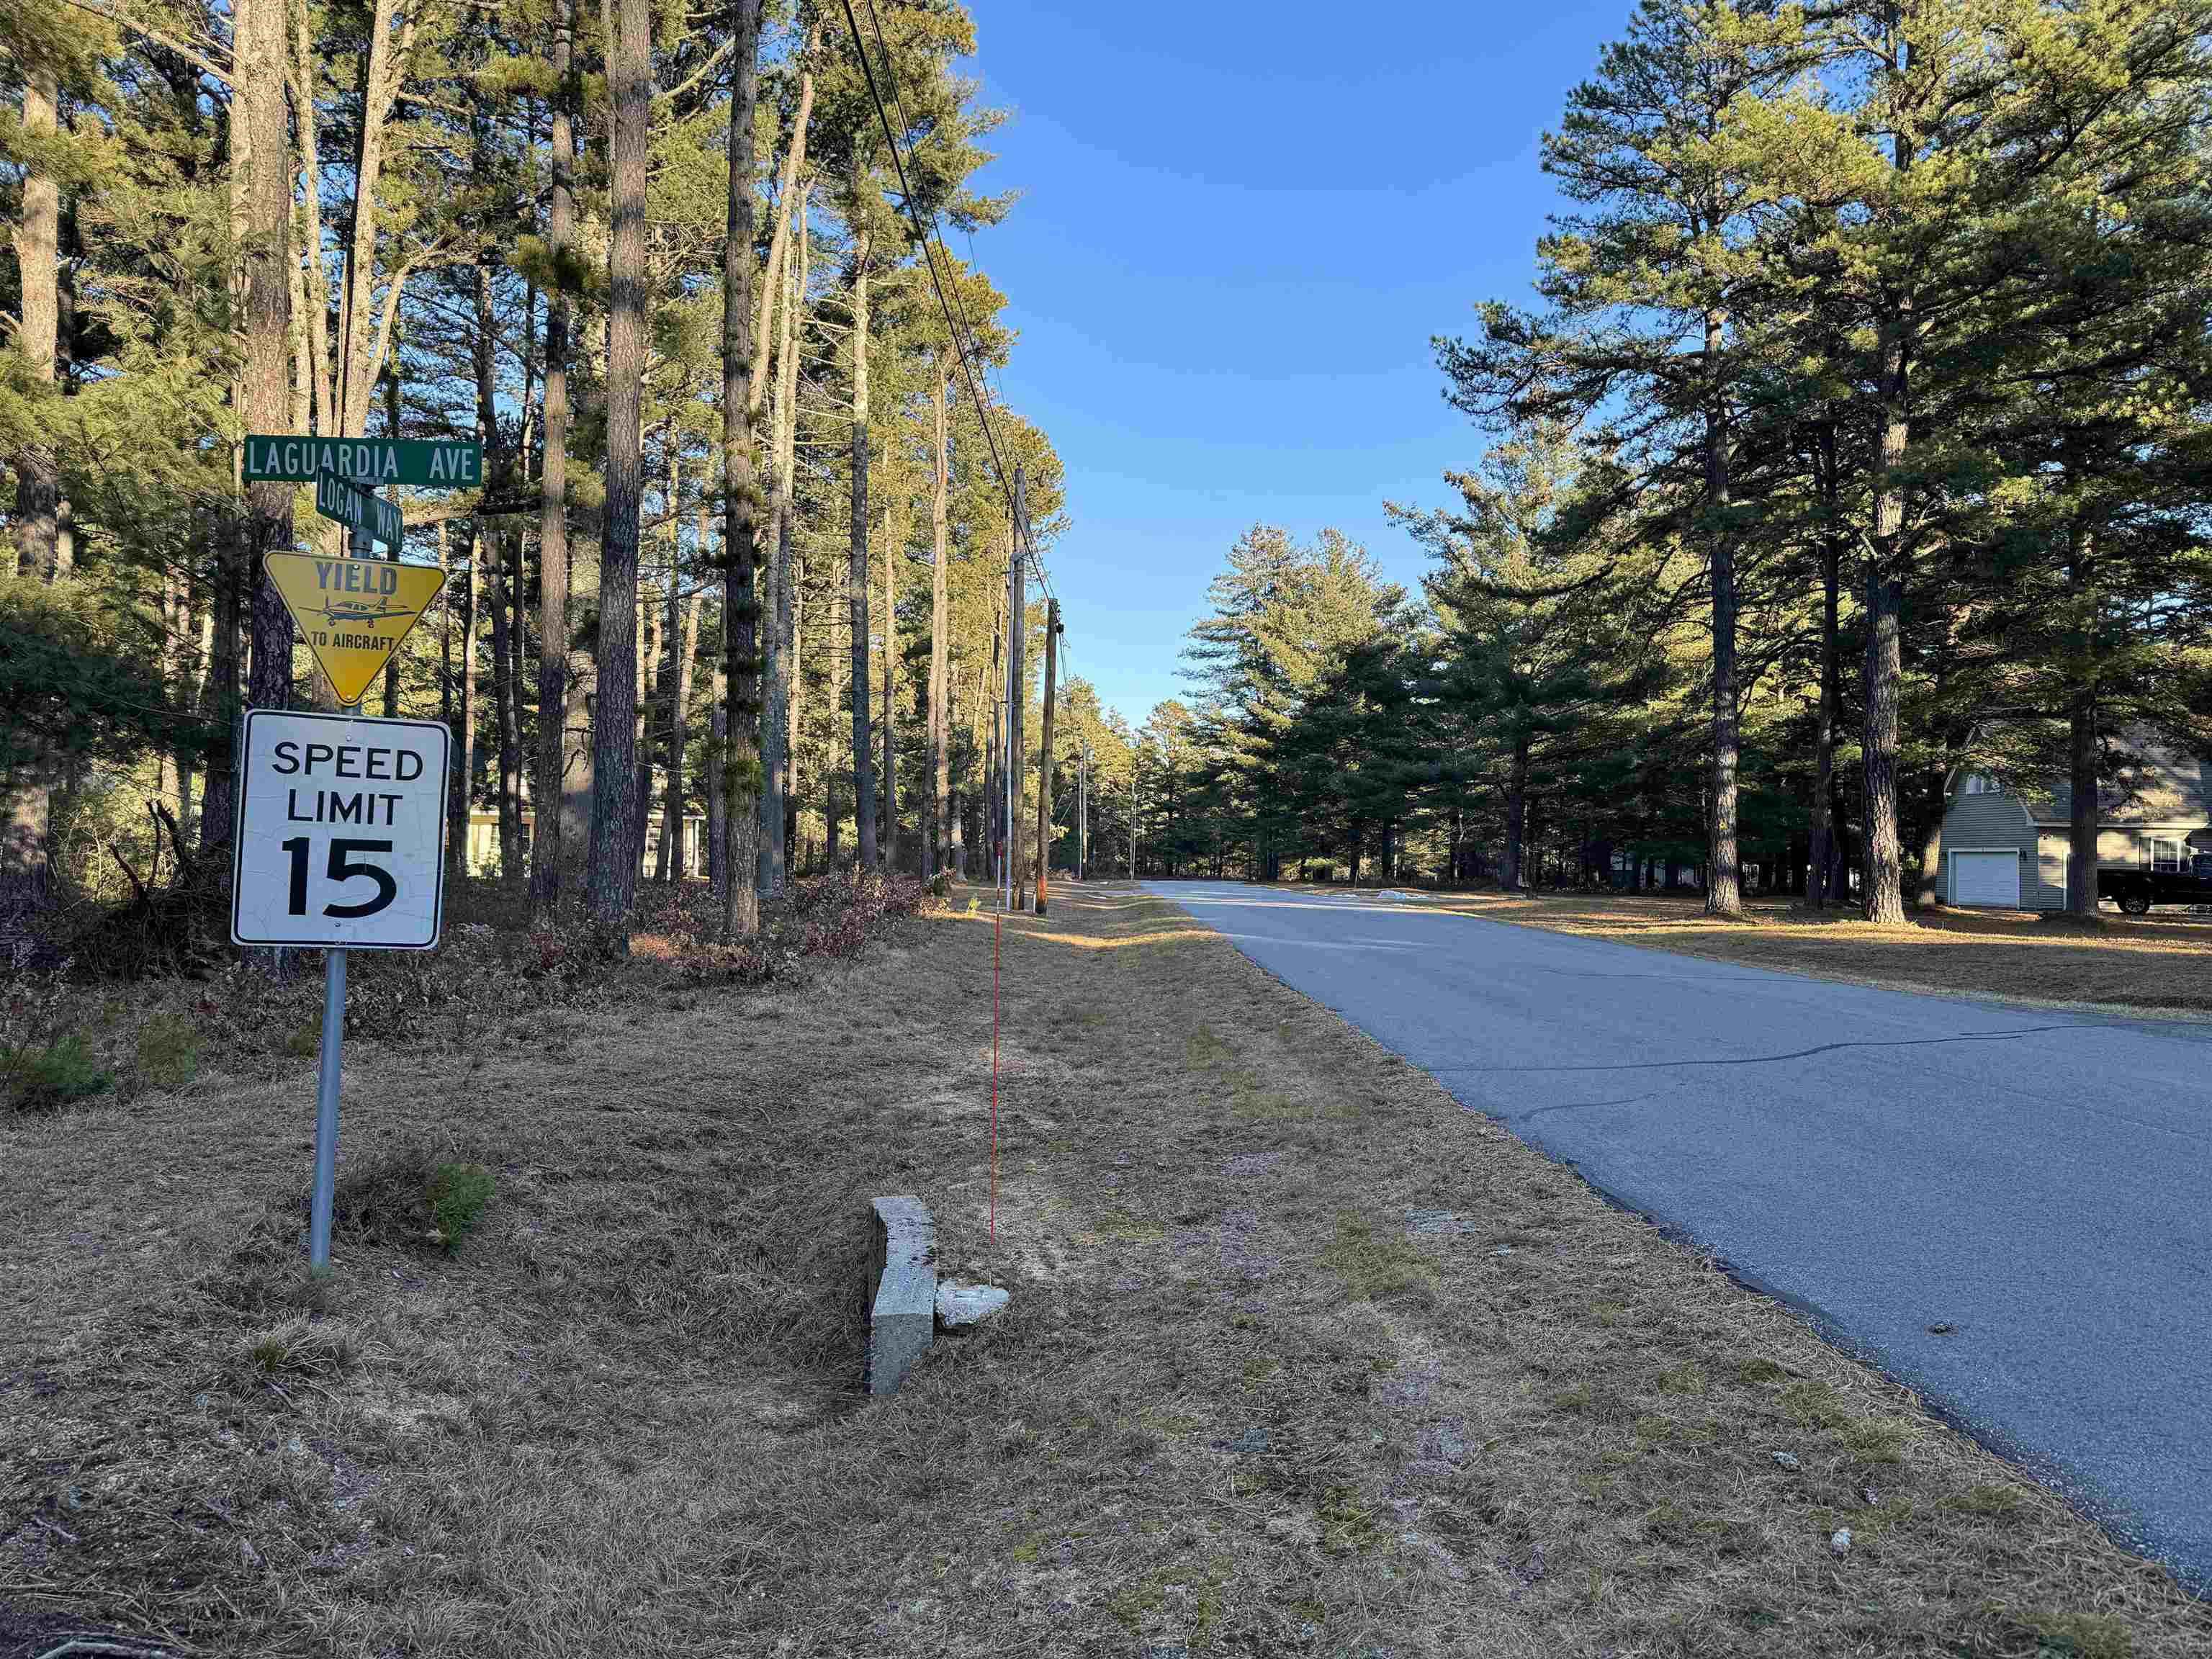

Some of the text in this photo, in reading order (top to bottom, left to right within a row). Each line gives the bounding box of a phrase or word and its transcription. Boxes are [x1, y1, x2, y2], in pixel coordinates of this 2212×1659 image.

[248, 441, 474, 481] LAGUARDIA AVE
[318, 472, 402, 544] LOGAN WAY
[315, 561, 397, 595] YIELD
[311, 631, 395, 652] TO AIRCRAFT
[271, 741, 423, 781] SPEED
[288, 788, 403, 826] LIMIT
[282, 837, 397, 919] 15
